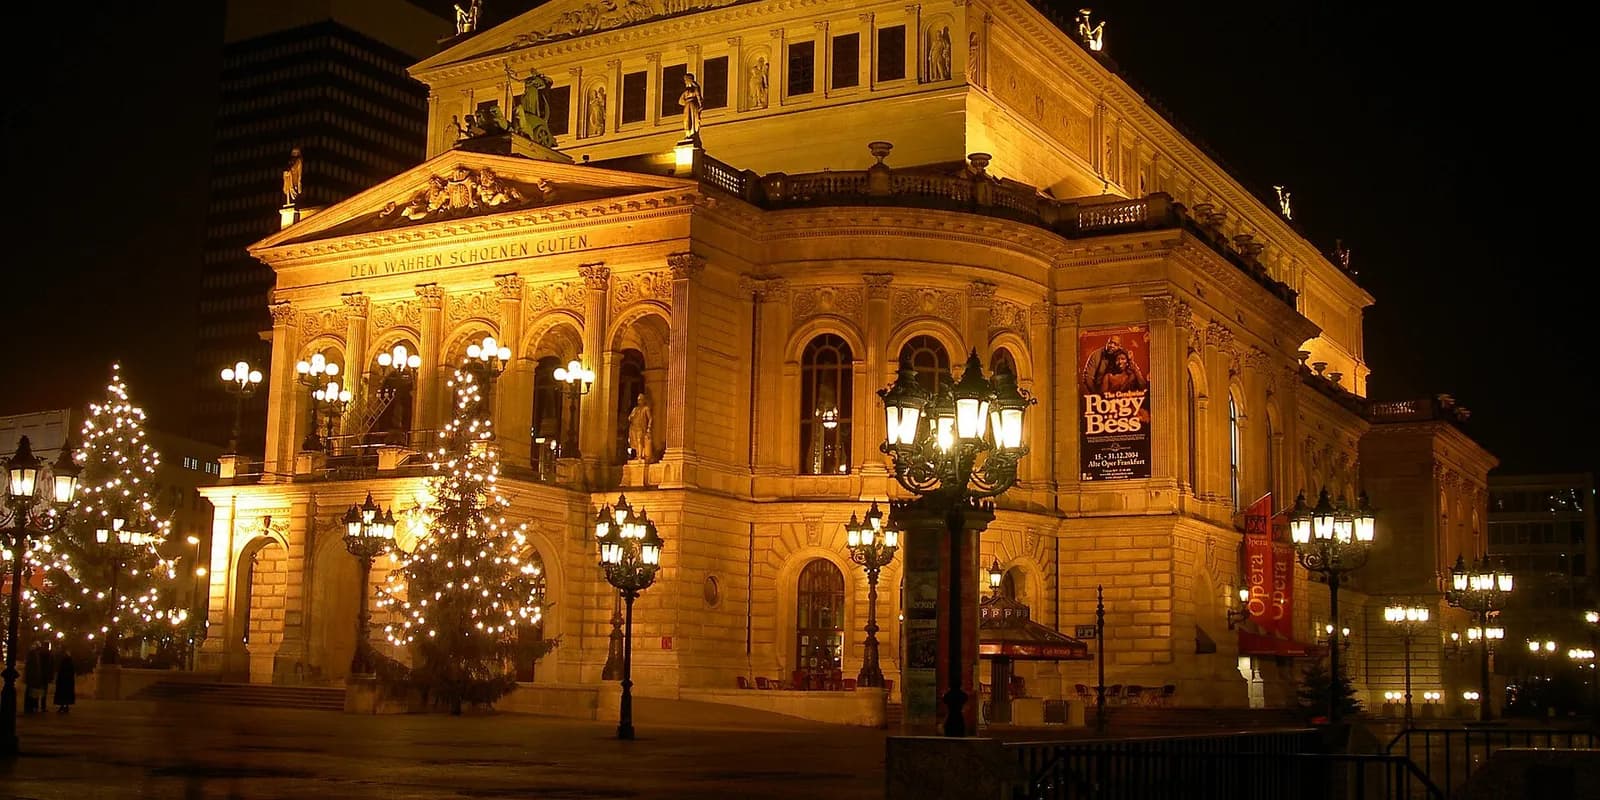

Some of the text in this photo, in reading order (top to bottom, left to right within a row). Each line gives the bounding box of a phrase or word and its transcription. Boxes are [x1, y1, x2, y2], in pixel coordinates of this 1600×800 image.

[350, 234, 593, 278] DEM WAHREN SCHOENEN GUTEN.
[1083, 394, 1145, 417] Porgy
[1084, 414, 1141, 435] Bess
[1101, 460, 1116, 468] Oper
[1248, 554, 1269, 617] Opera
